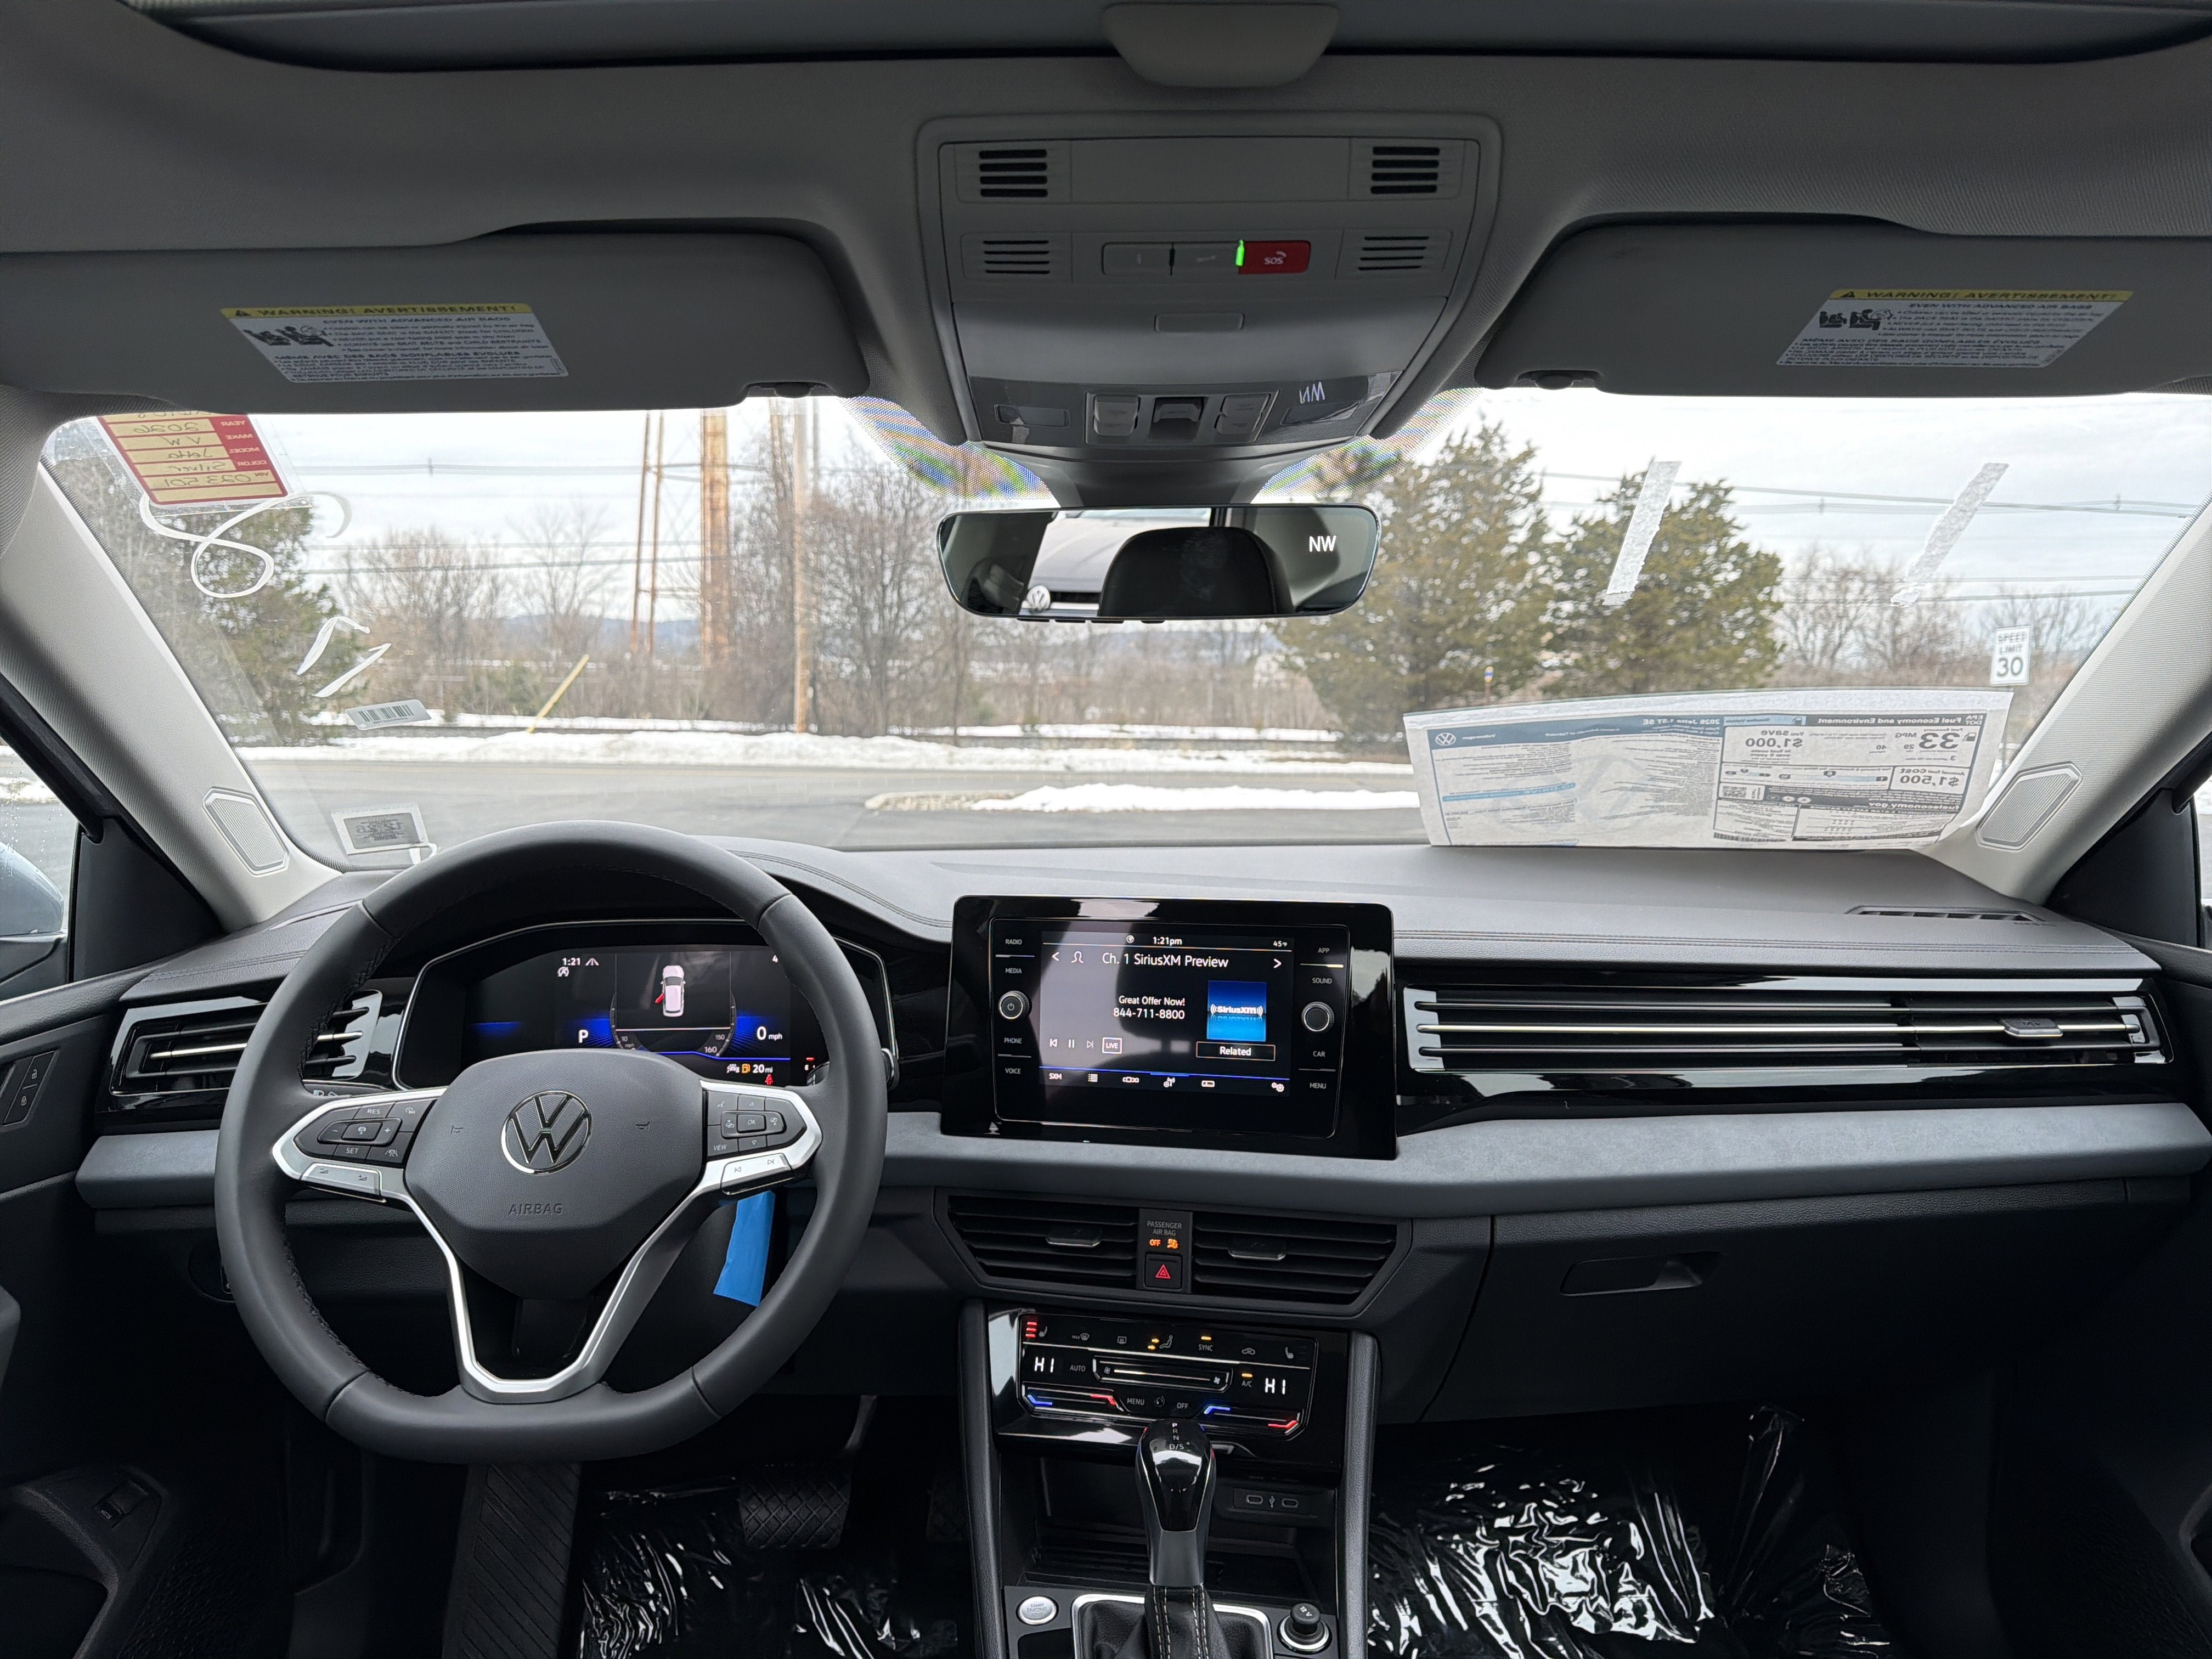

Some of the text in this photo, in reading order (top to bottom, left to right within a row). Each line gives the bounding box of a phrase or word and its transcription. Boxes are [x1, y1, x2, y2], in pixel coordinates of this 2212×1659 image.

[1308, 535, 1336, 552] NW
[1998, 631, 2026, 643] SPEED
[2000, 644, 2023, 655] LIMIT
[1996, 657, 2023, 676] 30
[1153, 936, 1182, 946] 1:21pm
[1102, 952, 1228, 969] Ch. 1 SiriusXM Preview
[1119, 995, 1186, 1006] Great Offer Now!
[1113, 1008, 1185, 1020] 844-711-8800
[579, 1029, 589, 1043] P
[757, 1026, 783, 1041] 0 mph
[1220, 1046, 1251, 1056] Related
[507, 1203, 563, 1216] AIRBAG
[1147, 1221, 1182, 1229] PASSENGER
